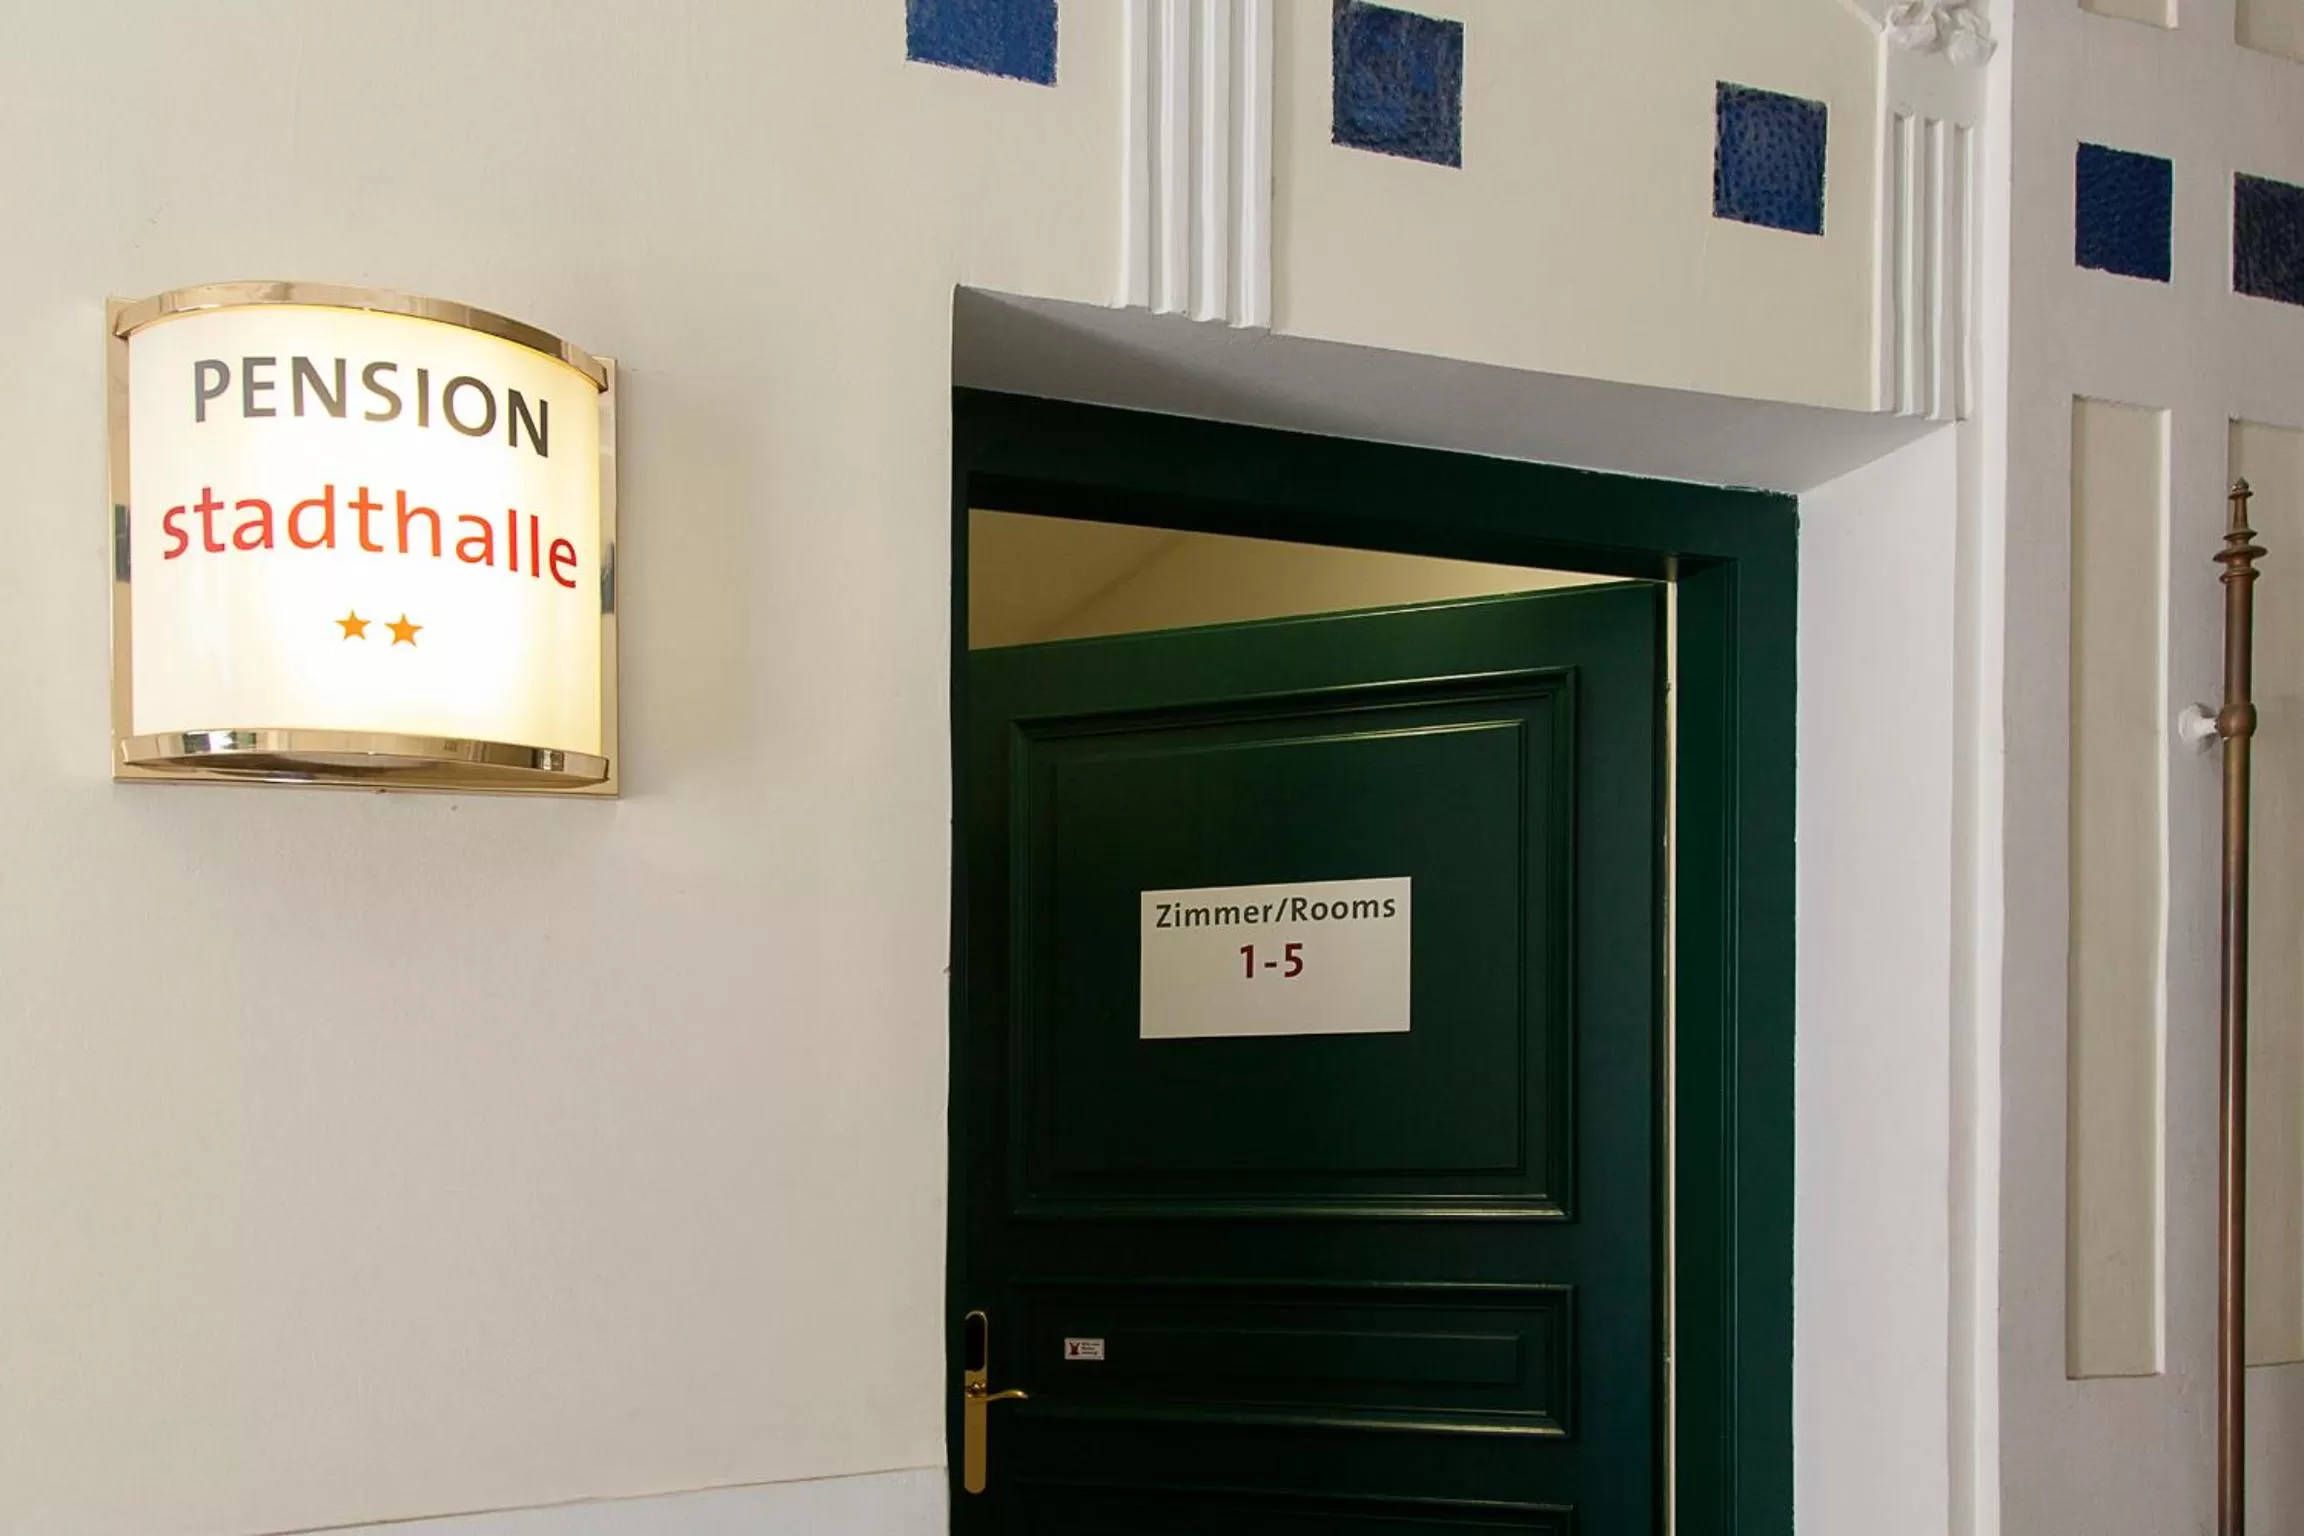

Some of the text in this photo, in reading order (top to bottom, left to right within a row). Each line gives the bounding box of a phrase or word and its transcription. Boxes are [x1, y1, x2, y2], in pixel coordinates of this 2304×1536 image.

[194, 355, 550, 459] PENSION
[162, 483, 579, 590] stadthalle
[1155, 897, 1397, 929] Zimmer/Rooms
[1240, 942, 1304, 979] 1-5
